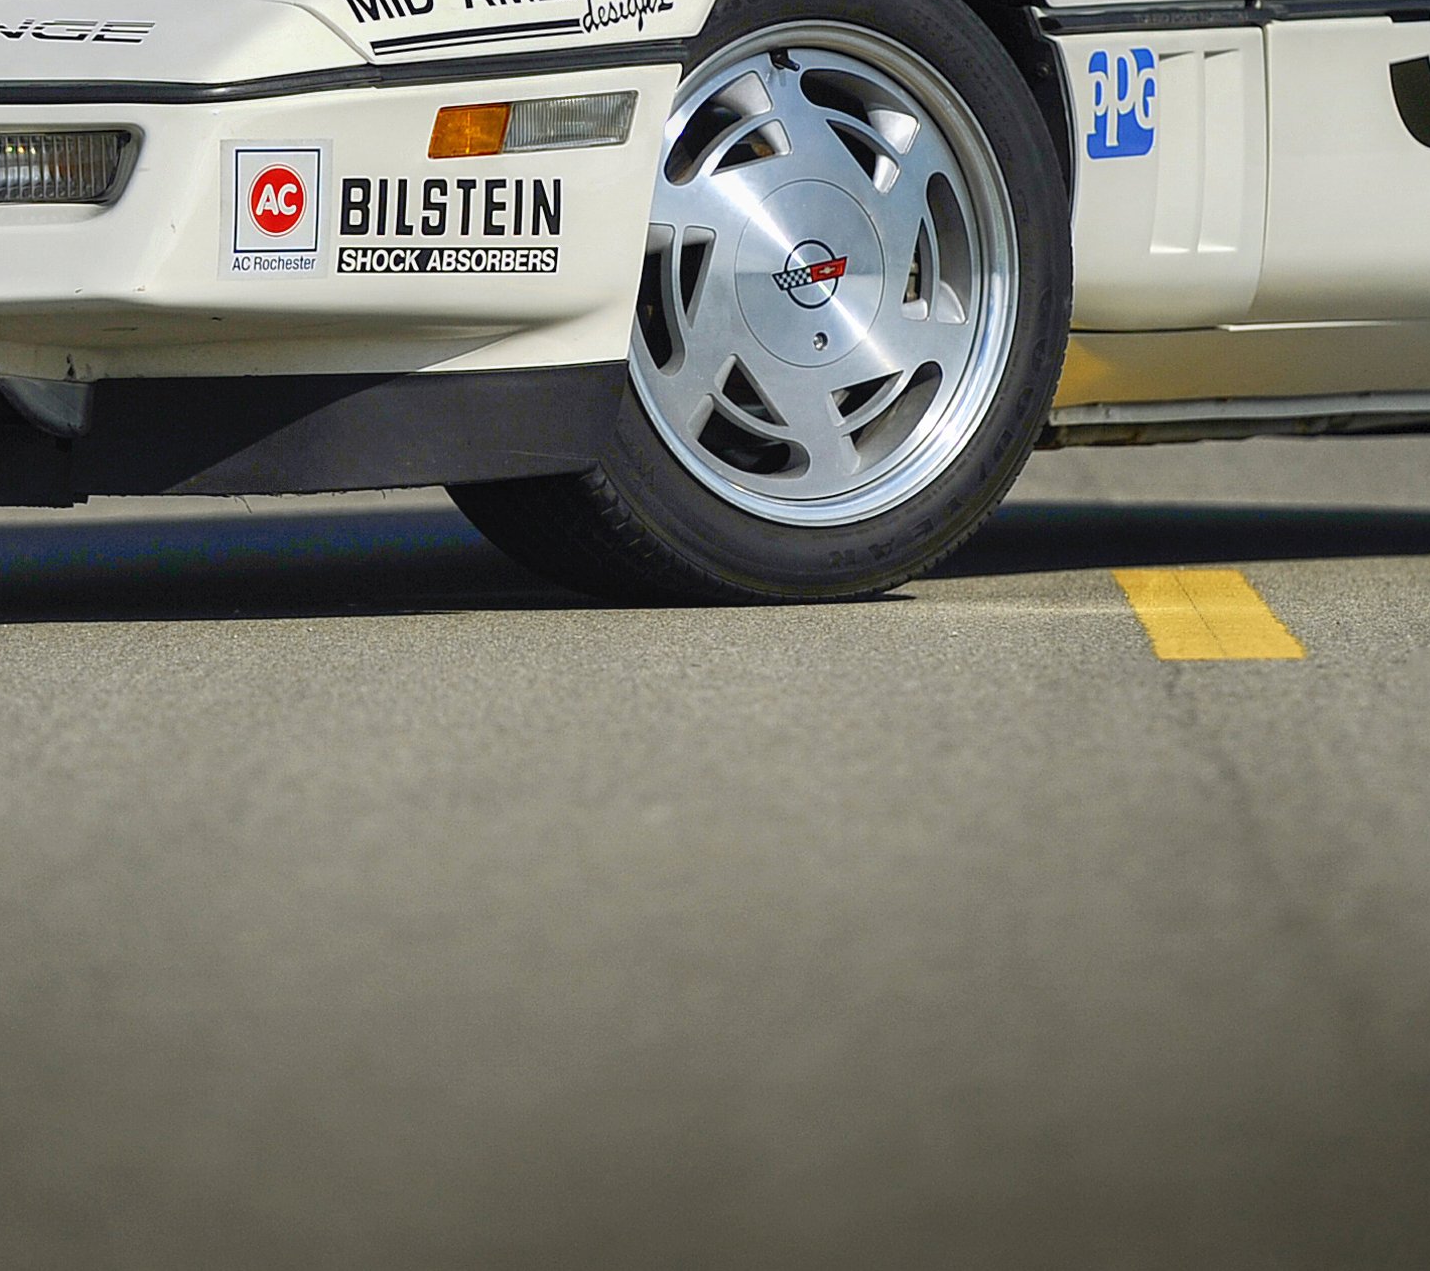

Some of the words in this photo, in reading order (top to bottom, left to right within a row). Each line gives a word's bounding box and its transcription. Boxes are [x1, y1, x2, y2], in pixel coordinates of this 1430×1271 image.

[255, 183, 298, 216] AC
[340, 178, 561, 236] BILSTEIN
[232, 258, 251, 271] AC
[253, 256, 316, 271] Rochester
[341, 250, 420, 272] SHOCK
[426, 250, 556, 272] ABSORBERS
